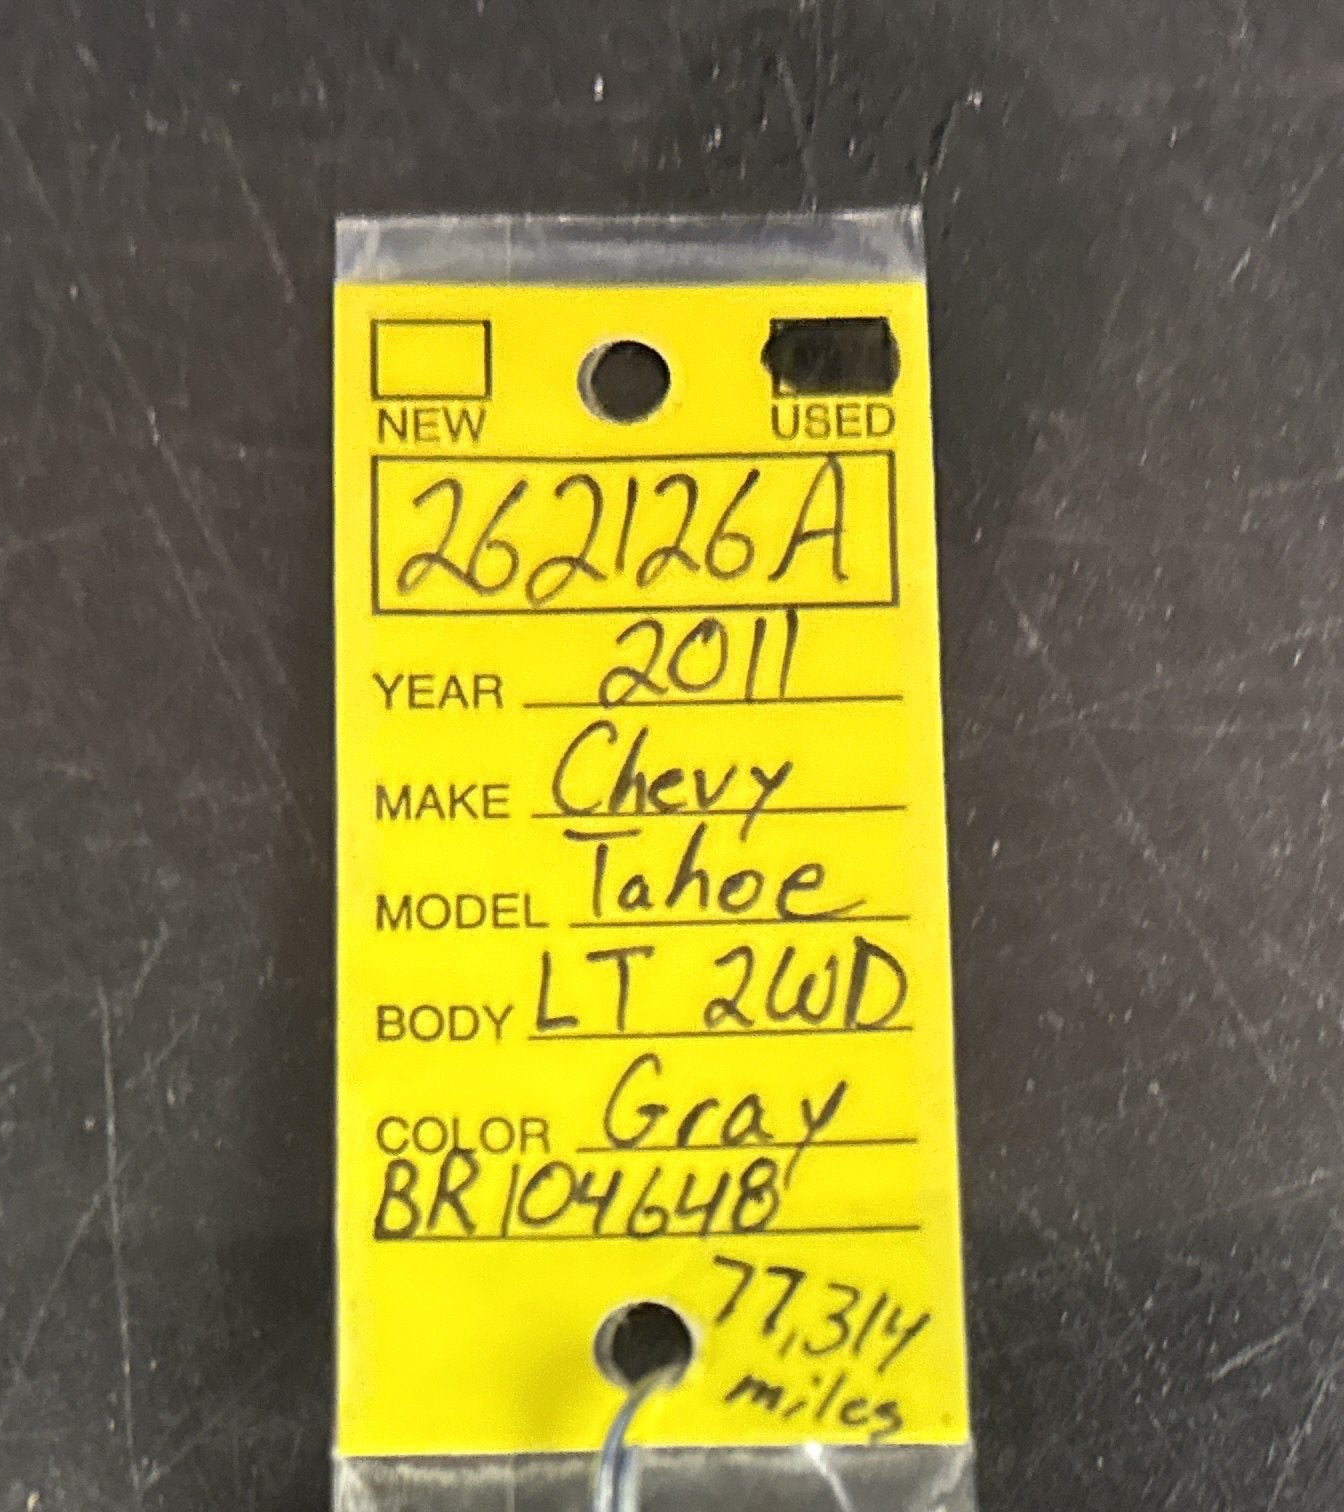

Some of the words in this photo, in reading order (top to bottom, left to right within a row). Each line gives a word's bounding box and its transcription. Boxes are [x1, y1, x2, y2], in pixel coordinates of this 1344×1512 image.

[378, 407, 486, 443] NEW
[771, 403, 896, 440] USED
[397, 453, 849, 608] 262126A
[598, 608, 799, 707] 2011
[372, 673, 503, 711] YEAR
[375, 784, 510, 820] MAKE
[551, 719, 793, 840] Chevy
[563, 822, 866, 922] Tahoe
[375, 894, 549, 930] MODEL
[536, 946, 654, 1033] LT
[703, 935, 908, 1032] 2WD
[377, 1005, 514, 1043] BODY
[376, 1116, 550, 1155] COLOR
[603, 1052, 847, 1188] Gray
[713, 1254, 930, 1373] 77,314
[725, 1372, 903, 1440] miles
